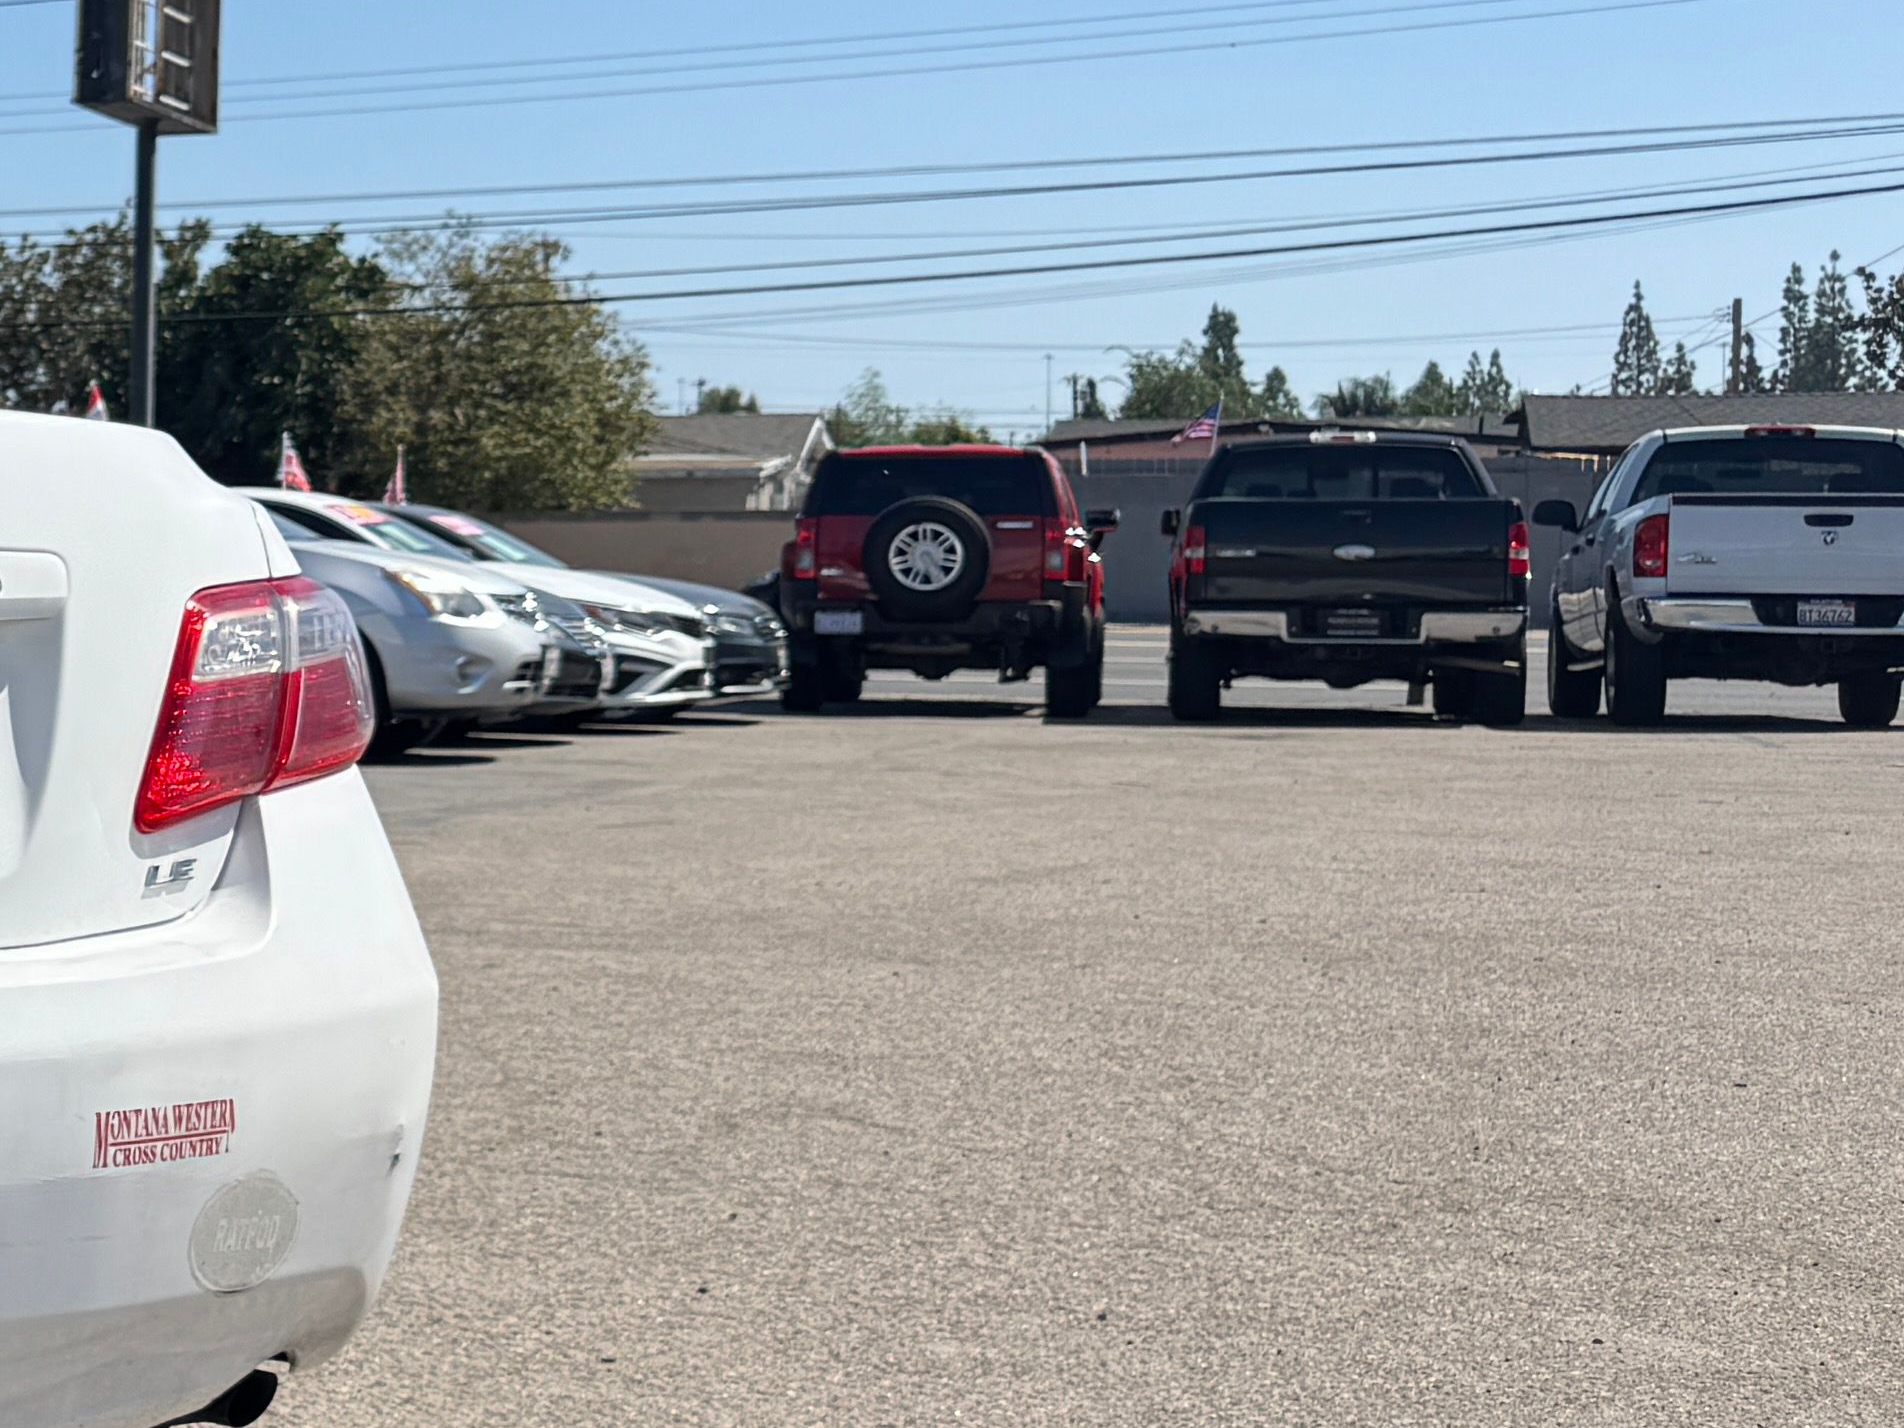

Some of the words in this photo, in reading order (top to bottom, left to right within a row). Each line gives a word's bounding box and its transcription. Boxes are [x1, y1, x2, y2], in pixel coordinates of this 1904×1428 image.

[144, 858, 198, 888] LE
[92, 1106, 170, 1169] MONTANA
[172, 1098, 236, 1153] WESTERN
[112, 1145, 157, 1168] CROSS
[160, 1136, 223, 1162] COUNTRY
